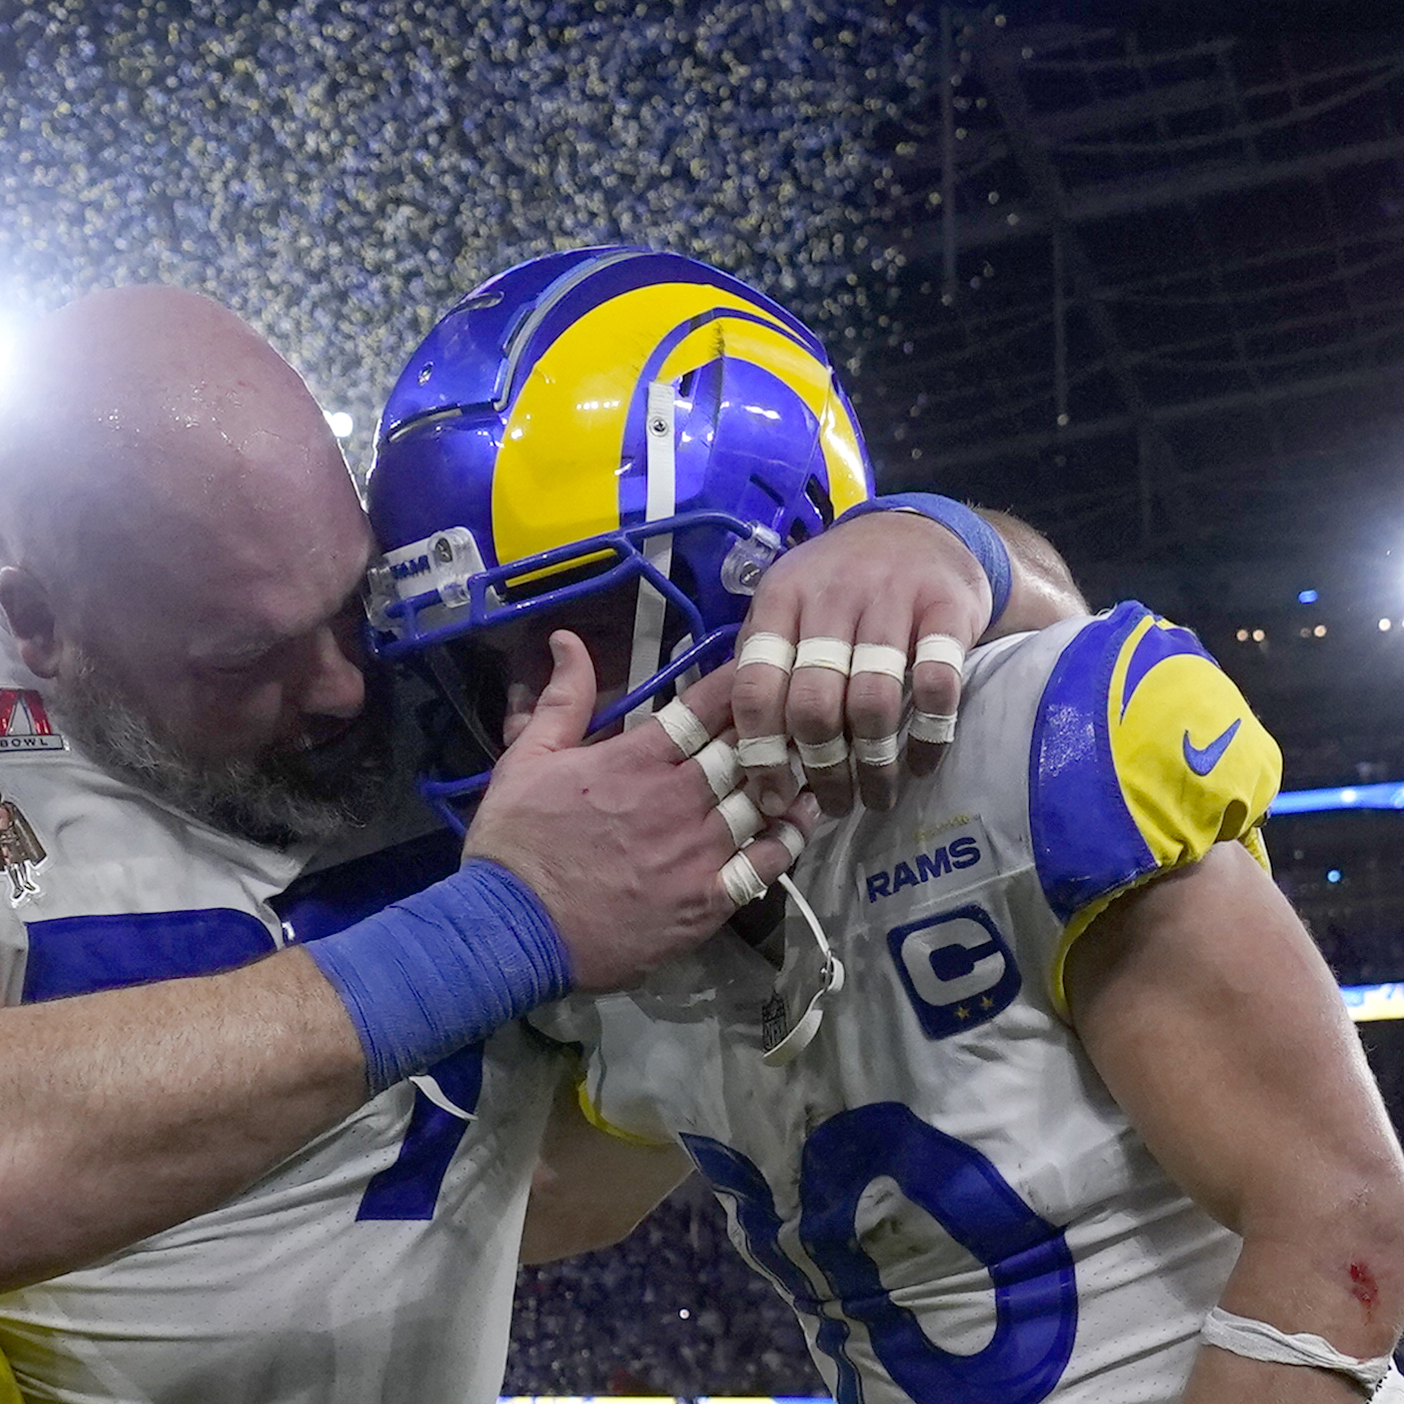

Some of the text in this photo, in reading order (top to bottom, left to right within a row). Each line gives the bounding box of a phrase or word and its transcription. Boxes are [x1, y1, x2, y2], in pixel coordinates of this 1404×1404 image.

[0, 737, 49, 749] BOWL
[866, 837, 981, 902] RAMS
[901, 917, 1006, 1007] C
